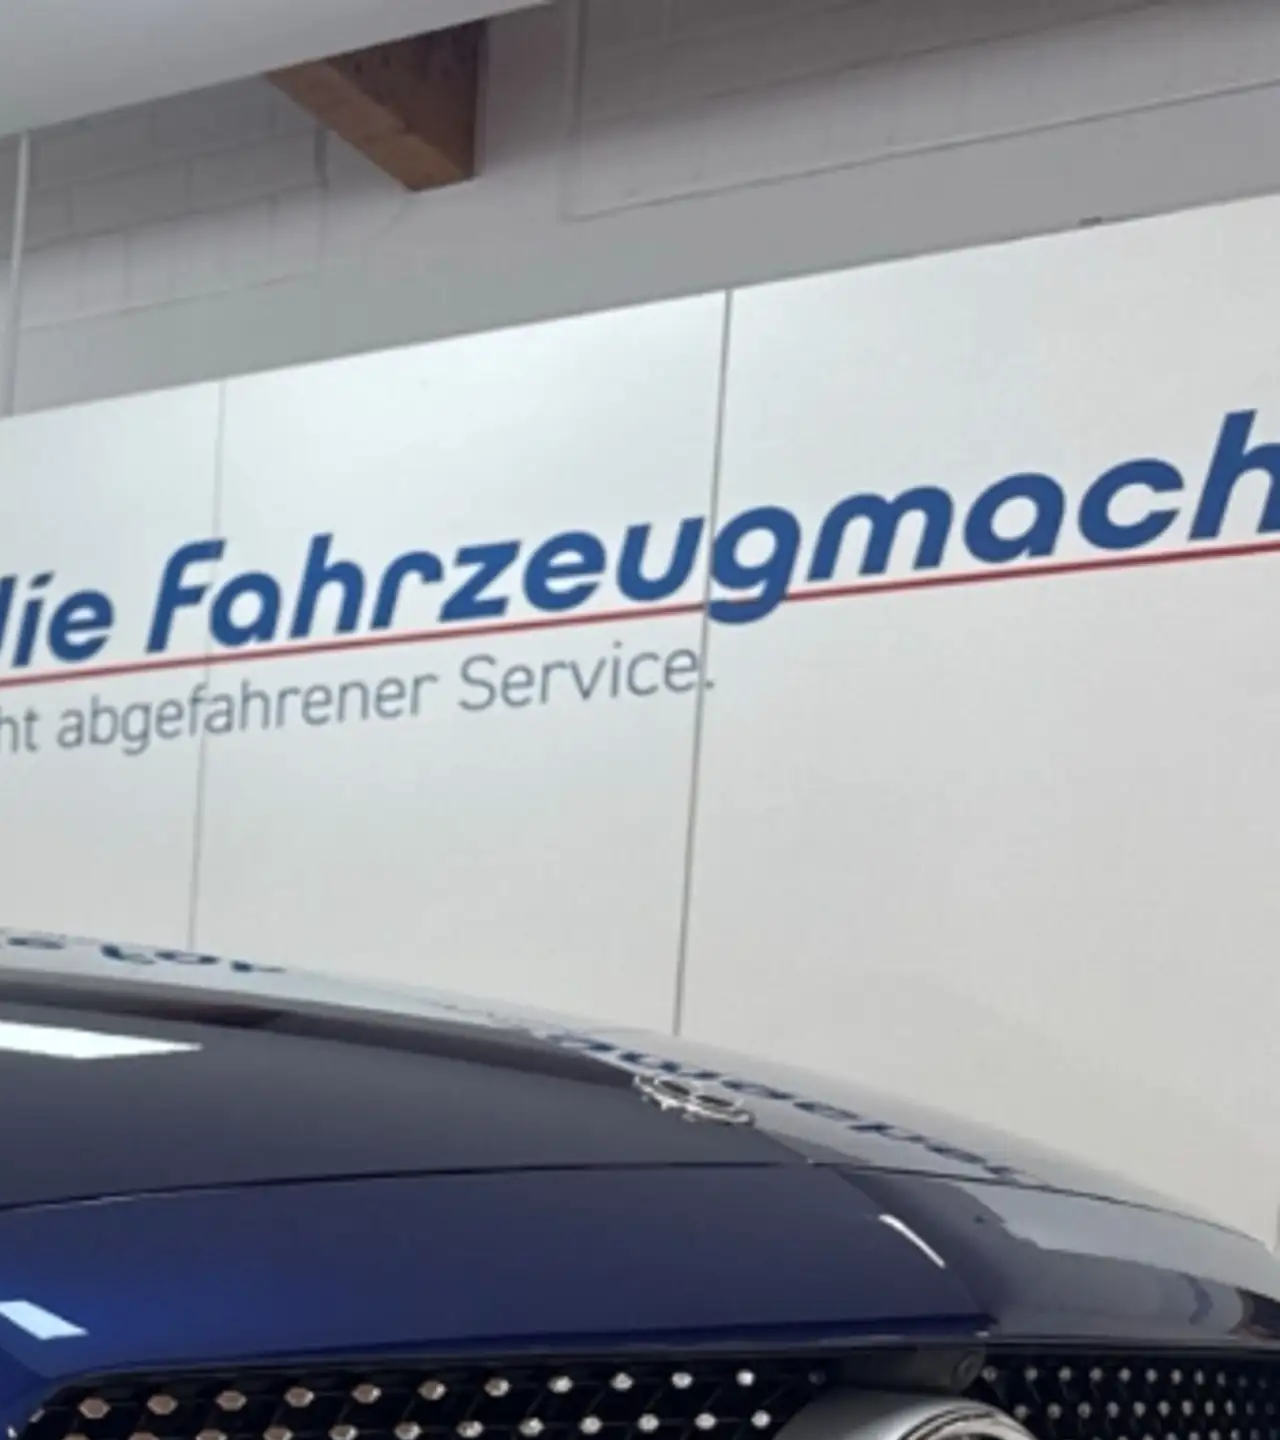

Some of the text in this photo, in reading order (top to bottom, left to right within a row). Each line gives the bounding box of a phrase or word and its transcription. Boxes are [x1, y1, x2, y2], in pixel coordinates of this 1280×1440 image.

[143, 408, 1280, 655] Fahrzeugmach
[57, 668, 440, 757] abgefahrener
[458, 640, 716, 713] Service.
